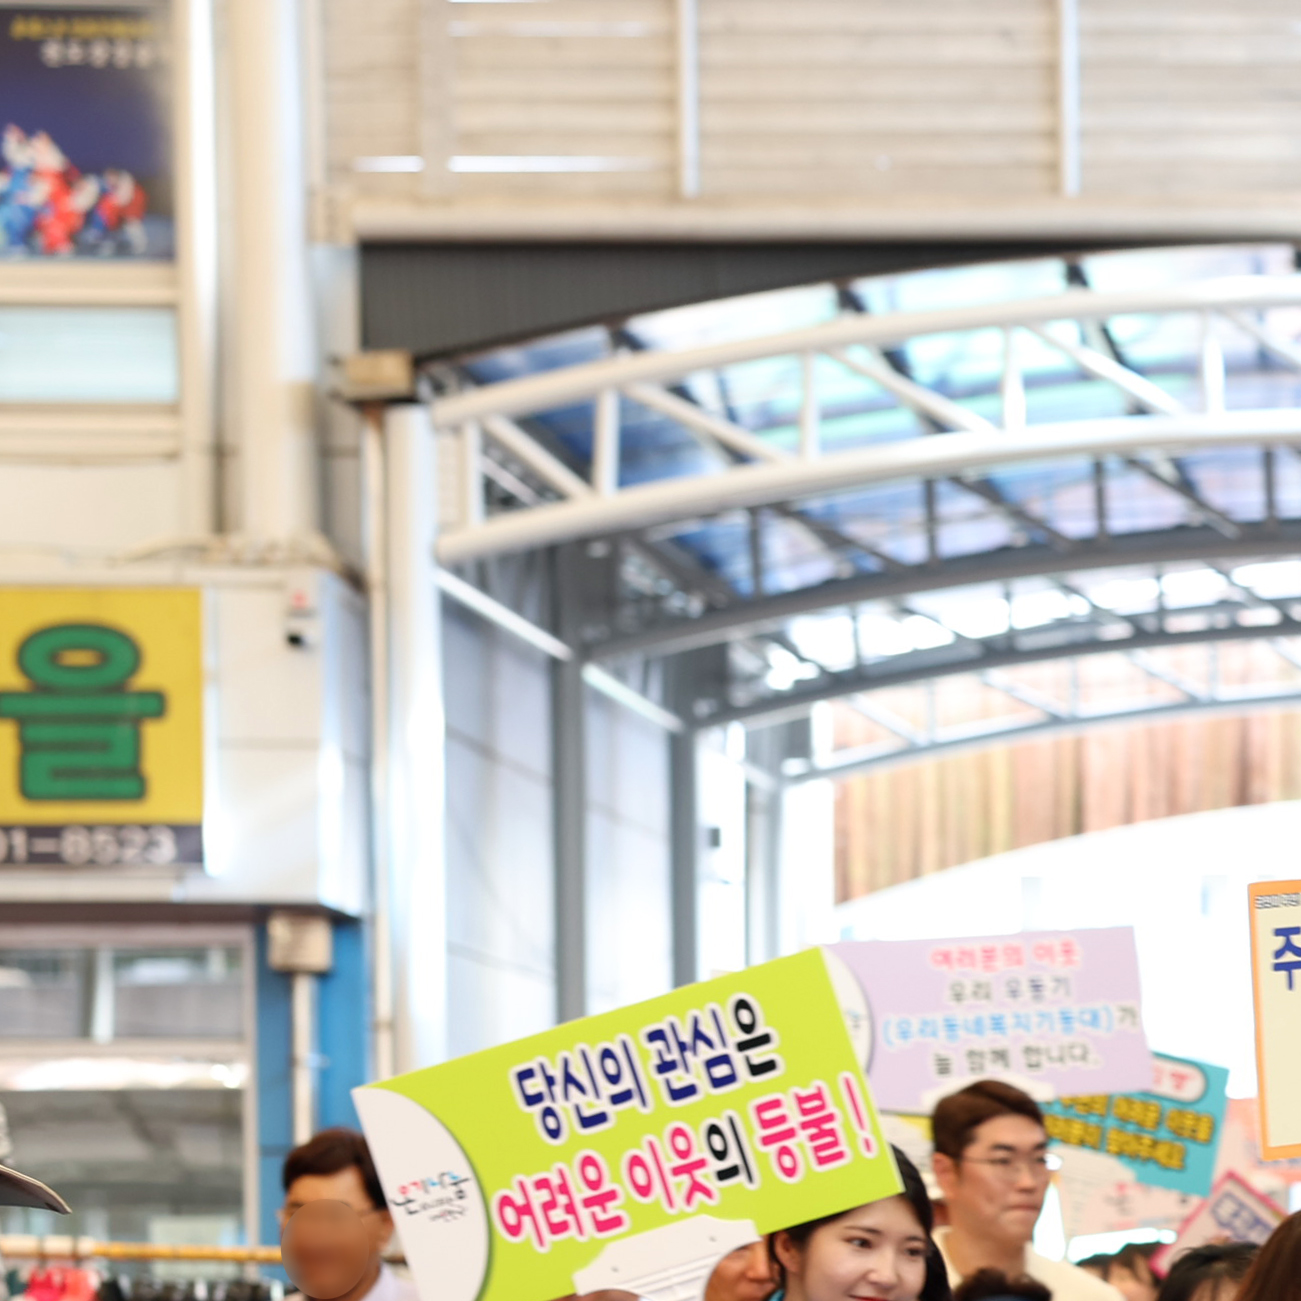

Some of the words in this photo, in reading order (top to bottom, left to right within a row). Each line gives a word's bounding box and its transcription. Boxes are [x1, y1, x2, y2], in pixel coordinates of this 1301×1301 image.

[515, 1038, 647, 1141] 당신의
[645, 998, 778, 1102] 관심은
[498, 1153, 627, 1248] 어려운
[627, 1114, 755, 1209] 이웃의
[755, 1085, 846, 1180] 등불
